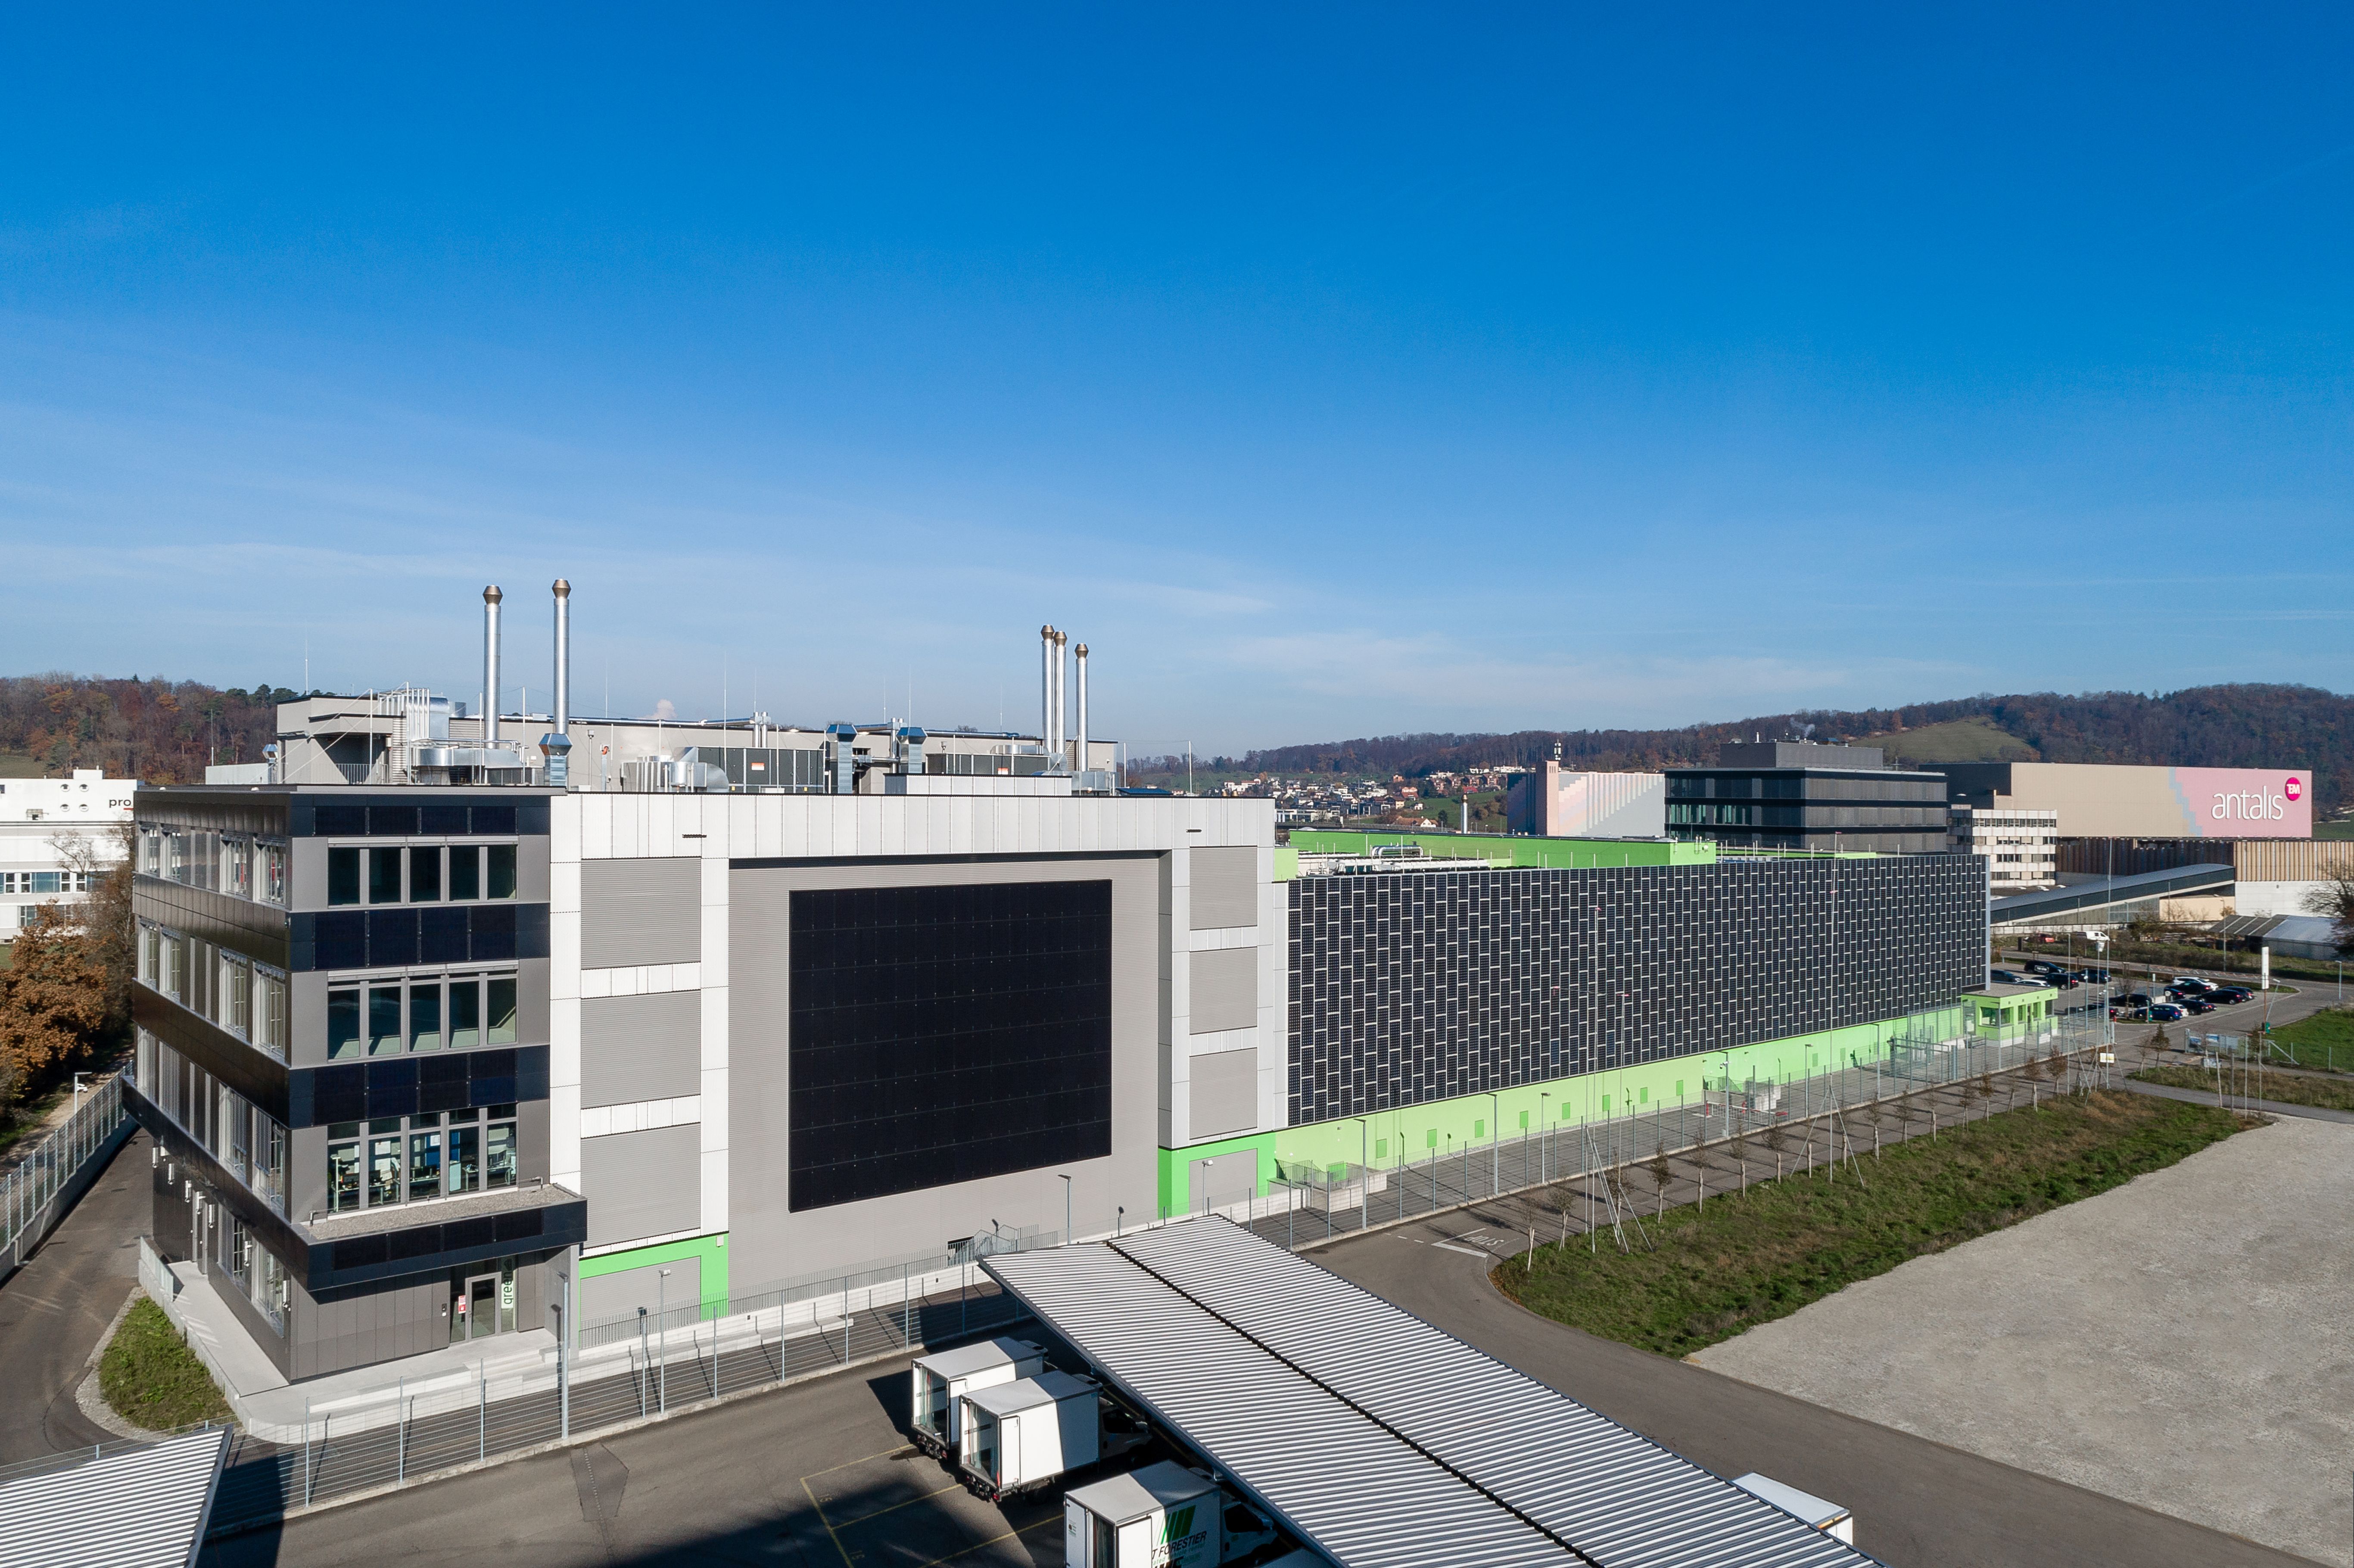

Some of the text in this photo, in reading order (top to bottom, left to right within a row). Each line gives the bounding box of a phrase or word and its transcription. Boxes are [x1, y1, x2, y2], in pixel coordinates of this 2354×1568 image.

[2211, 785, 2283, 820] antalis
[1464, 1235, 1504, 1246] STOP
[503, 1272, 514, 1304] green
[1158, 1531, 1207, 1557] FORESTIER
